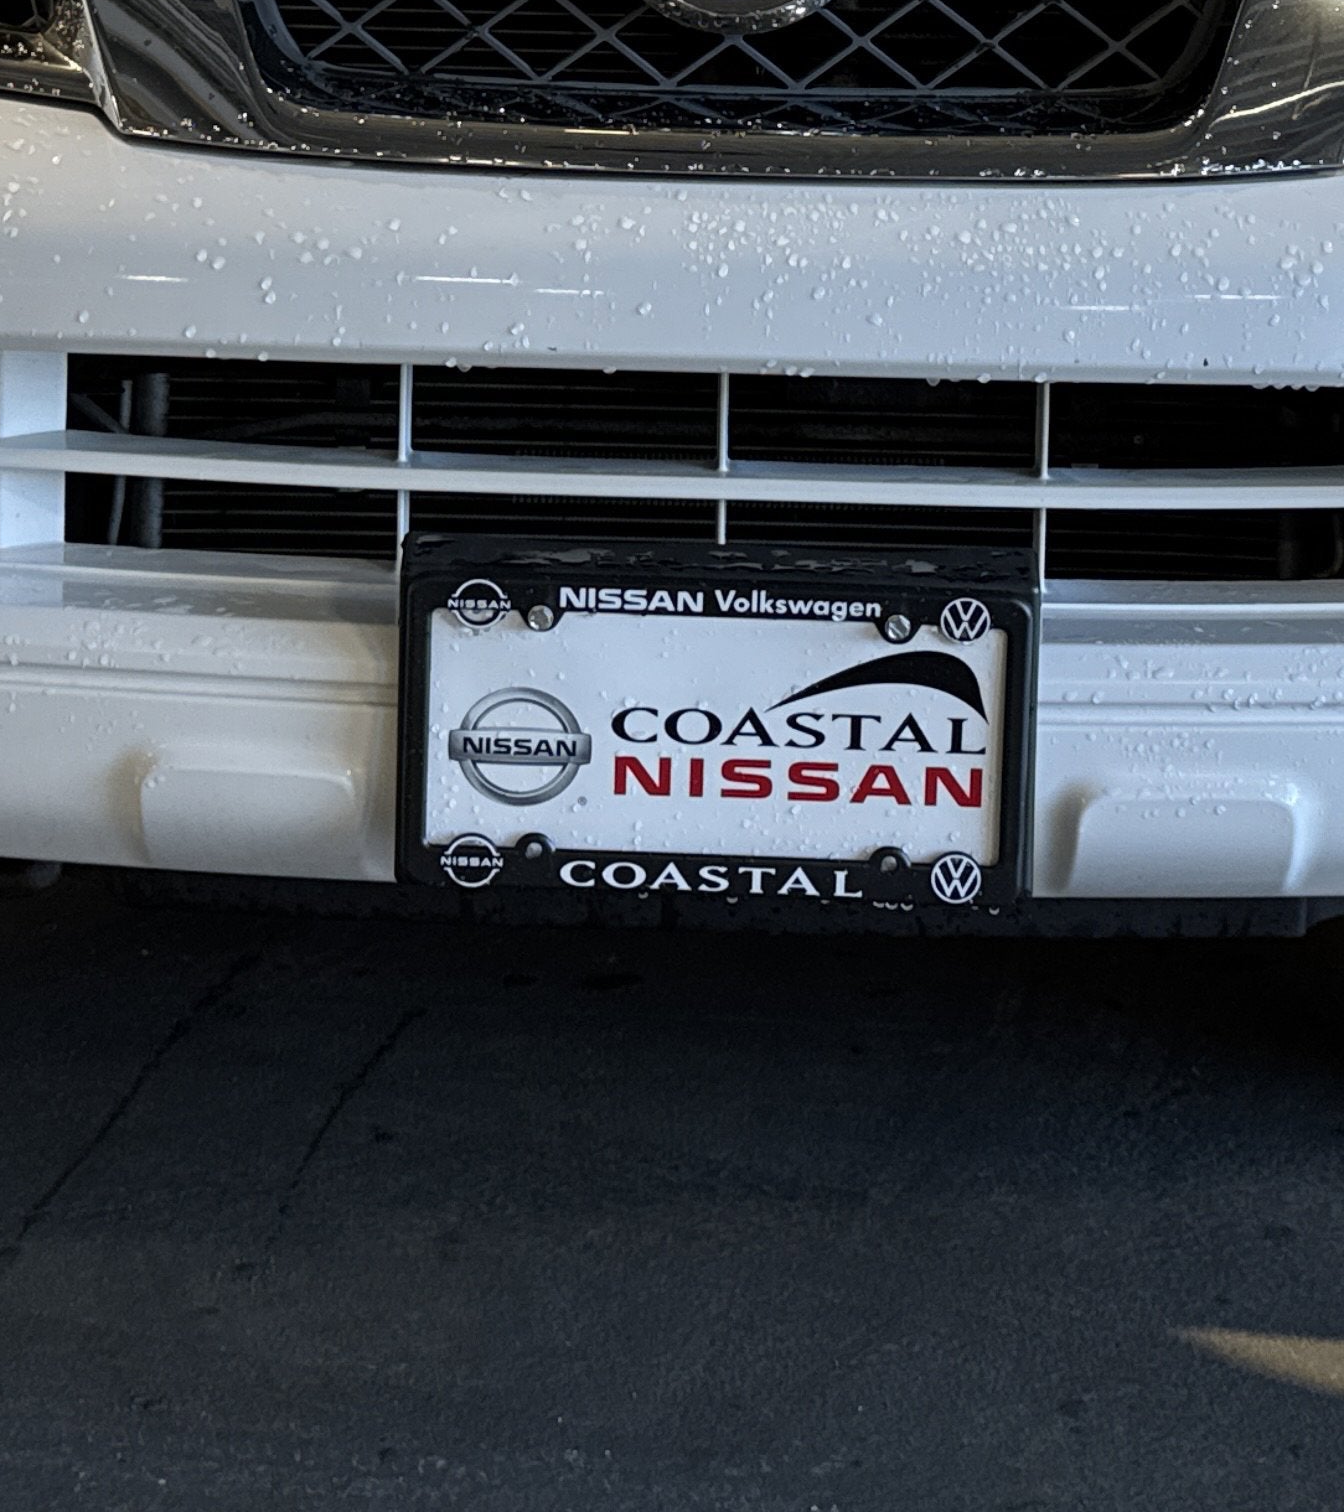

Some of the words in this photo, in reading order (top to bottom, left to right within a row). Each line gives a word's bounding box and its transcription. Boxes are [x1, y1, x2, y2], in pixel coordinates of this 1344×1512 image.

[447, 598, 512, 611] NISSAN
[559, 586, 704, 613] NISSAN
[714, 589, 882, 622] Volkswagen
[462, 736, 577, 757] NISSAN
[610, 706, 987, 756] COASTAL
[613, 755, 983, 808] NISSAN
[439, 855, 504, 869] NISSAN
[558, 859, 863, 899] COASTAL
